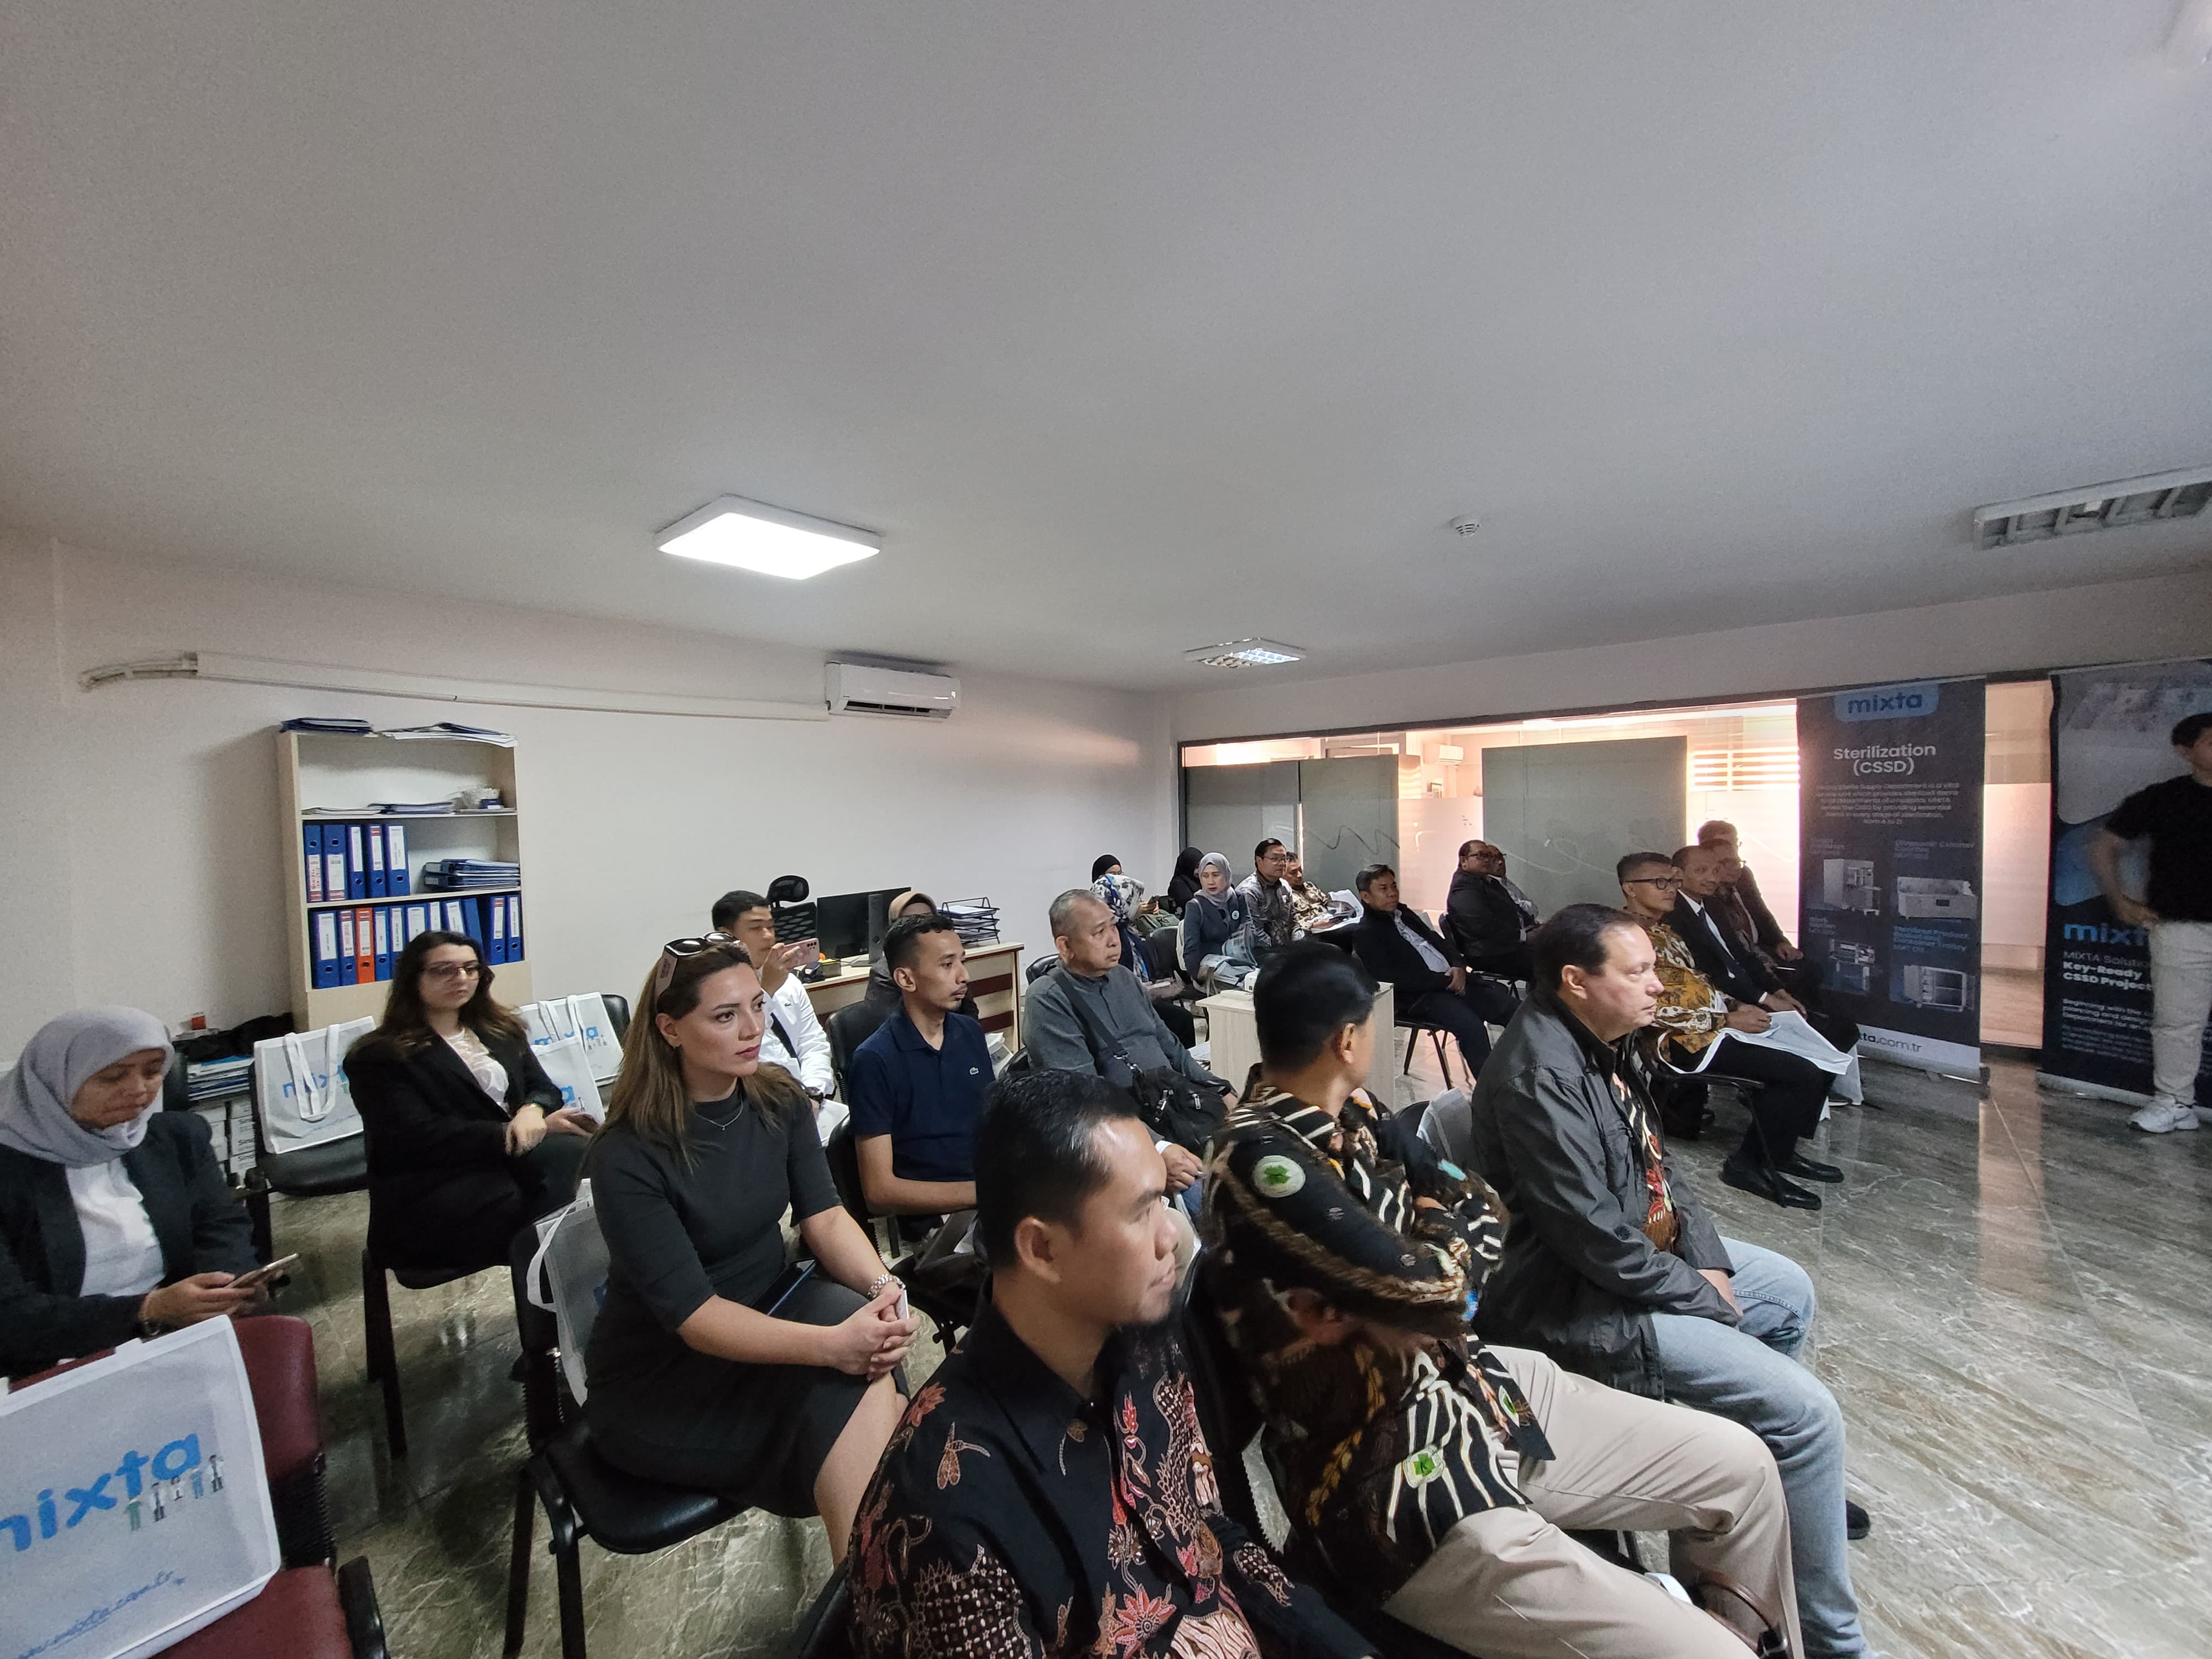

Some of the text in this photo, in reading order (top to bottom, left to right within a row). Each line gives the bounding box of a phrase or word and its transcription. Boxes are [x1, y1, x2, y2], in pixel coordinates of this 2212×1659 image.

[1848, 692, 1922, 714] mixta
[1834, 743, 1936, 760] Sterilization
[1853, 757, 1914, 776] (CSSD)
[2063, 922, 2148, 947] mixt
[2063, 951, 2100, 962] MIXTA
[2063, 961, 2142, 980] Key-Ready
[2063, 972, 2099, 983] CSSD
[1859, 1032, 1922, 1052] ta.com.tr
